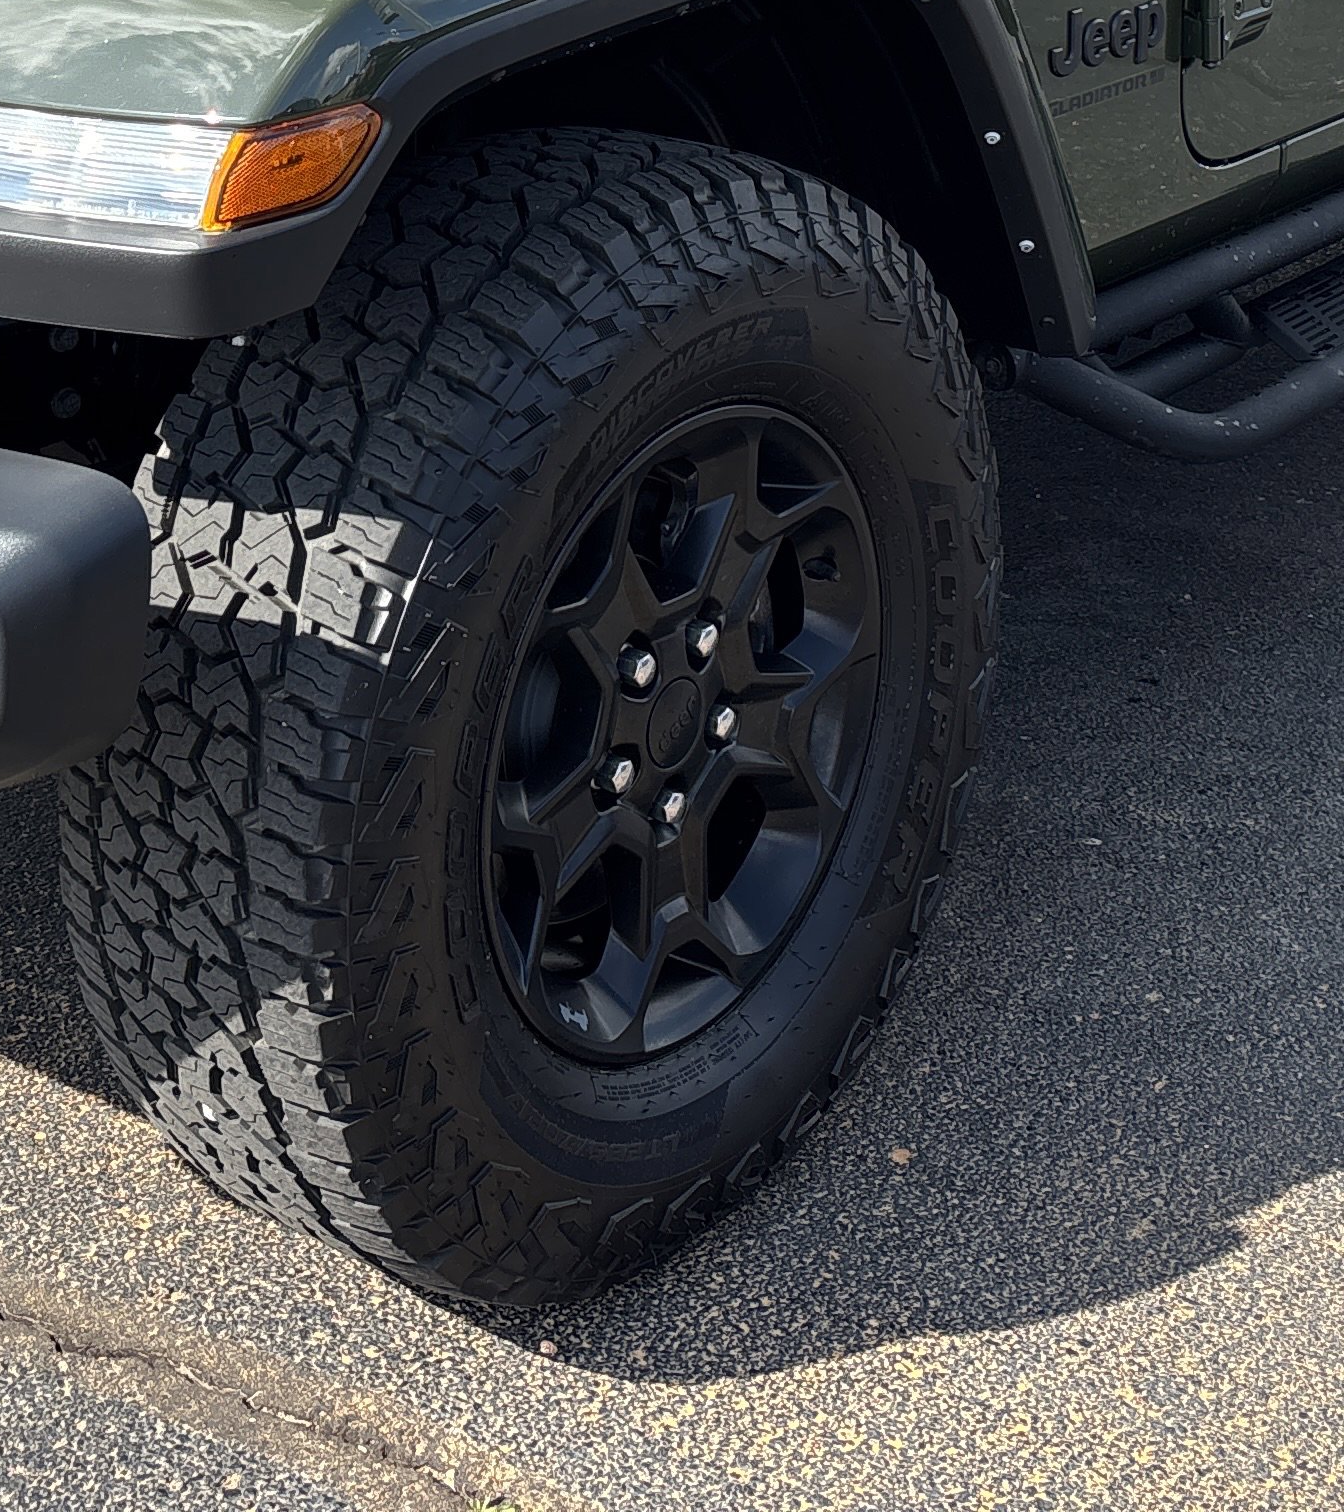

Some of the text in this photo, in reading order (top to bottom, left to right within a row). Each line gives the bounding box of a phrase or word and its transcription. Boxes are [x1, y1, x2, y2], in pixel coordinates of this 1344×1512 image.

[1048, 0, 1167, 78] Jeep
[1049, 73, 1148, 117] GLADIATOR
[658, 694, 698, 754] Jeep
[876, 504, 958, 896] COOPER
[444, 552, 538, 1025] COOPER
